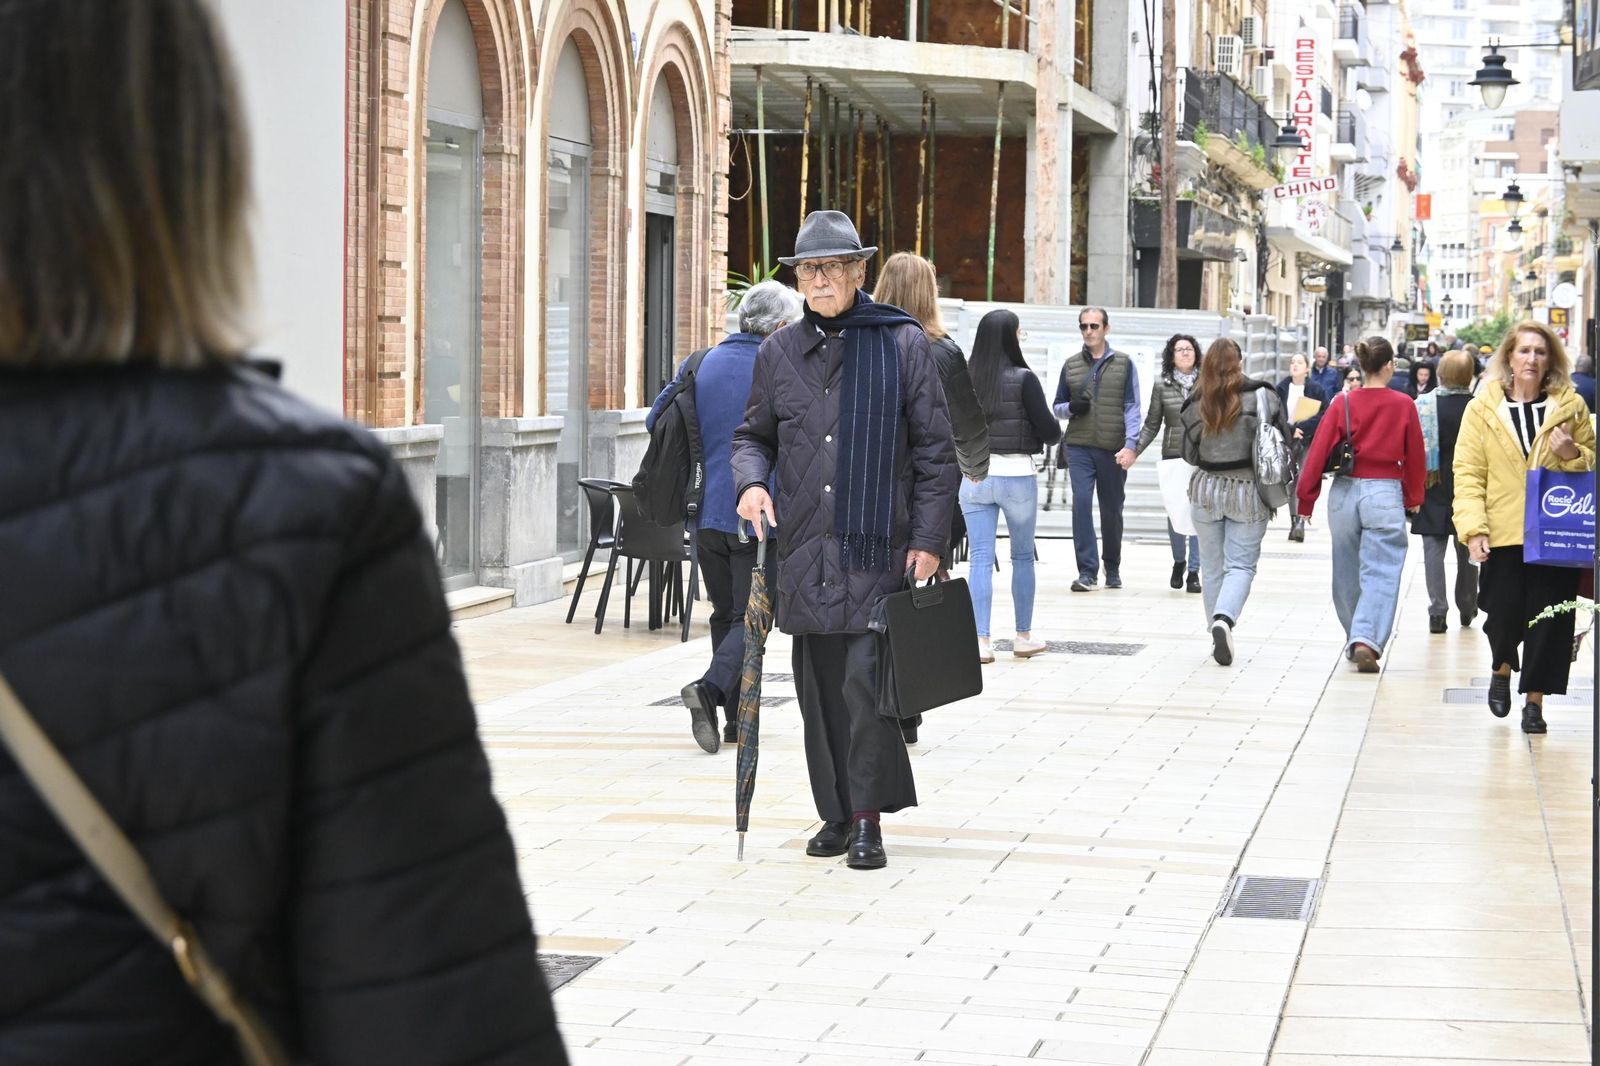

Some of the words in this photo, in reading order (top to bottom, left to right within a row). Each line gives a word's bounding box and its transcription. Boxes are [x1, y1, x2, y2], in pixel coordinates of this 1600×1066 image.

[1292, 38, 1315, 178] RESTAURANTE
[1273, 178, 1336, 199] CHINO
[1548, 494, 1572, 503] Rocío
